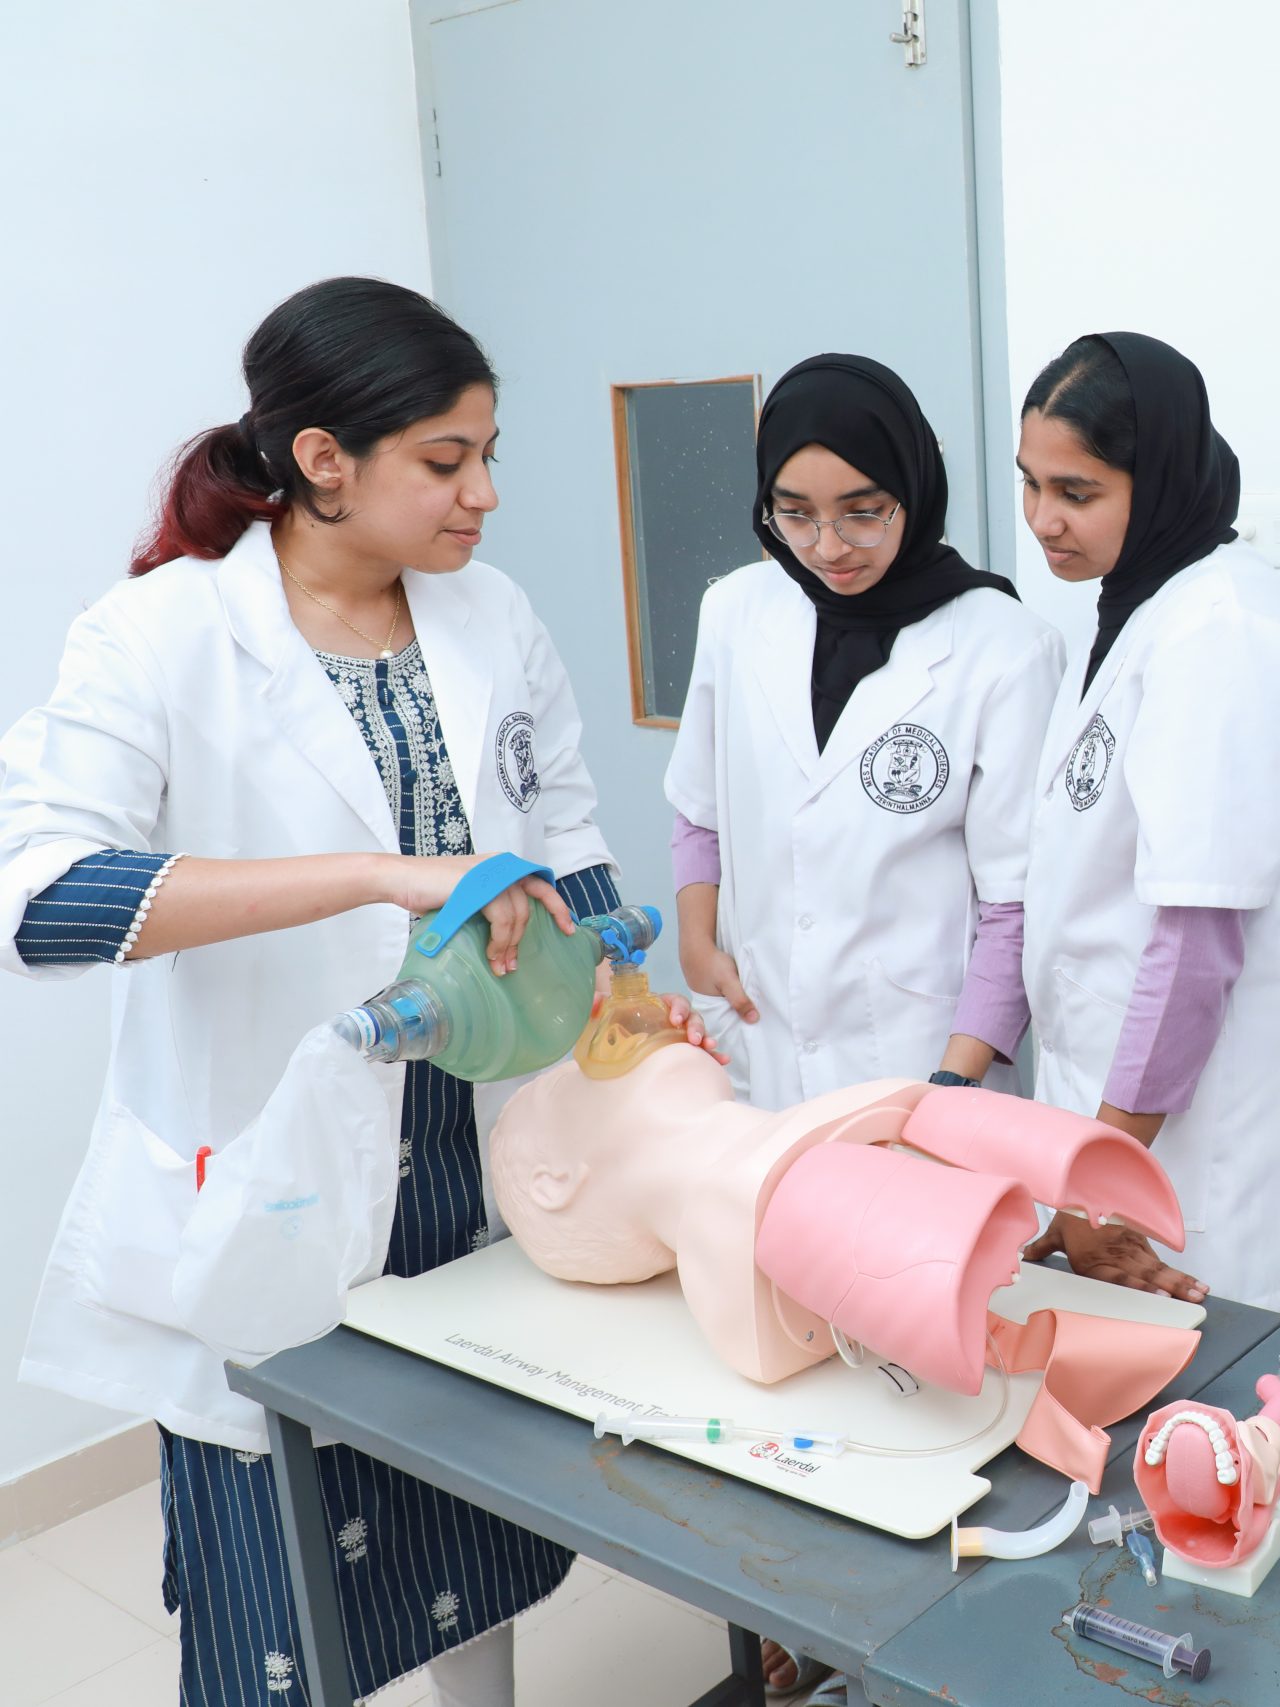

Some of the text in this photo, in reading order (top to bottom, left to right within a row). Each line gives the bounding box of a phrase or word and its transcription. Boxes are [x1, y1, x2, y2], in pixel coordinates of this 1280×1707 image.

[498, 720, 513, 748] MEDICAL
[498, 751, 503, 760] OF
[863, 726, 946, 790] MES ACADEMY OF MEDICAL SCIENCES
[875, 794, 932, 811] PERINTHALMANNA
[443, 1332, 504, 1359] Laerdal
[492, 1352, 549, 1377] Airway
[544, 1370, 644, 1412] Management
[773, 1452, 822, 1474] Laerdal
